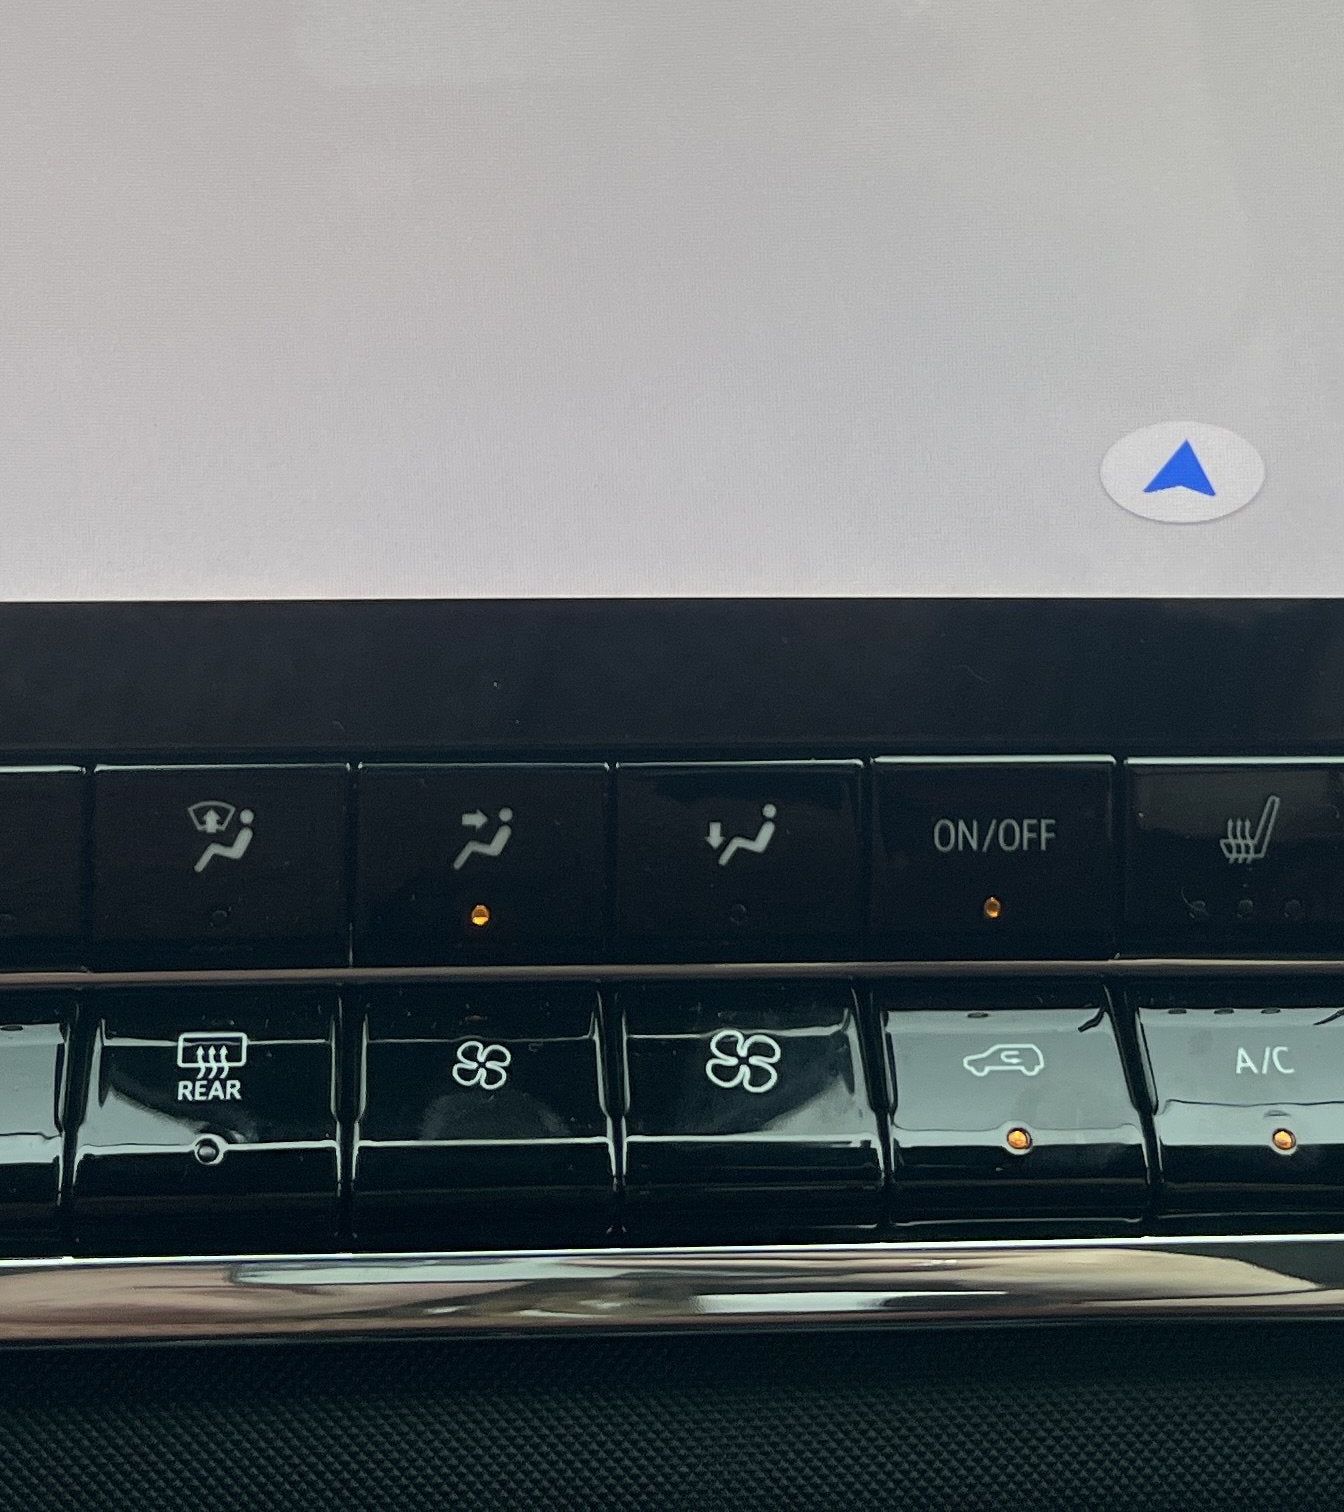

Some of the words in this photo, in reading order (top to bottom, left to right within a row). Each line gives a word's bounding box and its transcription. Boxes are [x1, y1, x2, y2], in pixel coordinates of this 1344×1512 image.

[932, 817, 1056, 855] ON/OFF
[1233, 1045, 1296, 1076] A/C
[177, 1079, 242, 1101] REAR
